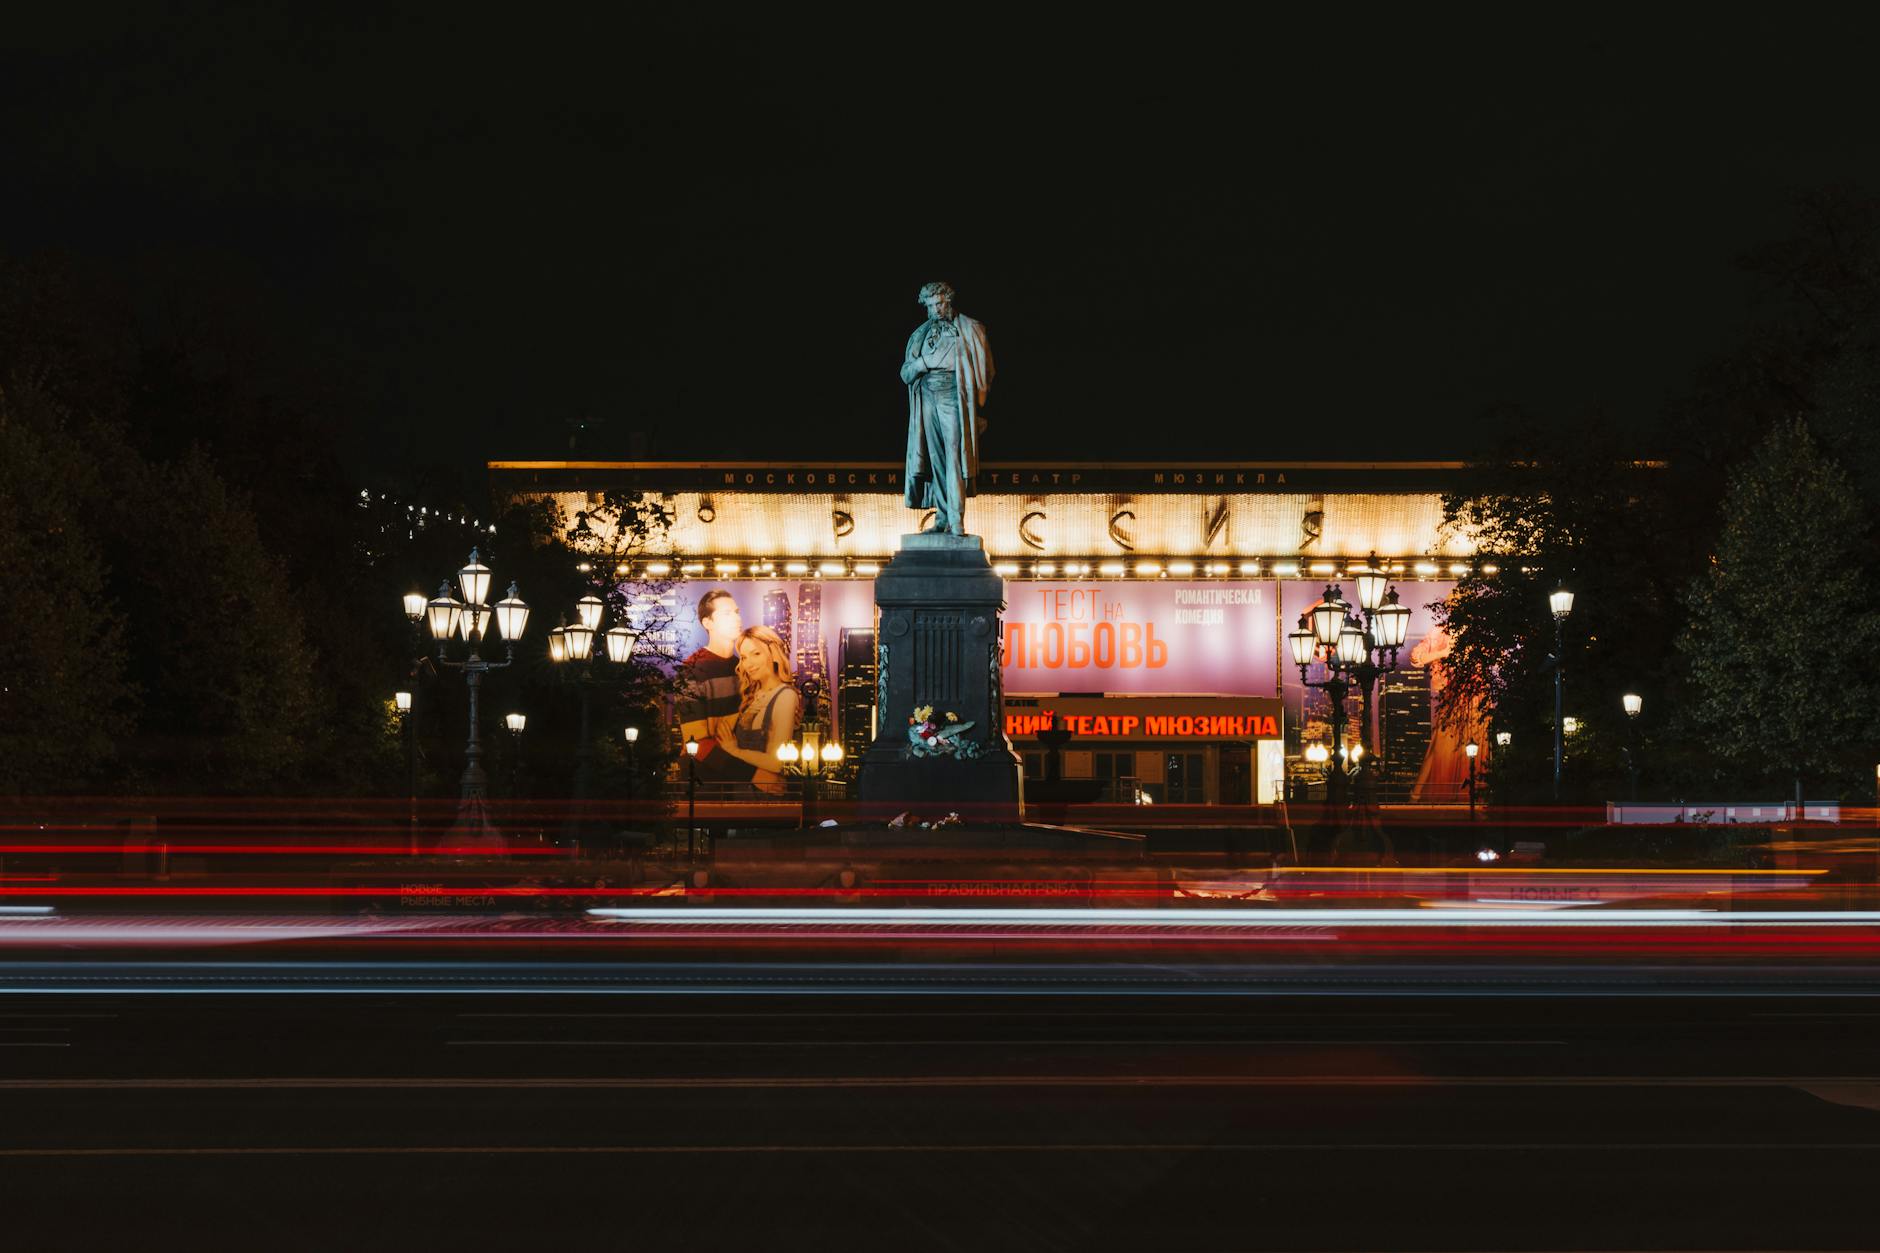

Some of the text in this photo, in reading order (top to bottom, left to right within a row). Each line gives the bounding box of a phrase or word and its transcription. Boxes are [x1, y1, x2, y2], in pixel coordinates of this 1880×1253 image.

[724, 473, 1287, 485] МОСКОВСКИ ТЕАТР МЮЗИКЛА
[1037, 589, 1125, 621] ТЕСТ НА
[1174, 588, 1262, 606] РОМАНТИЧЕСКАЯ
[1174, 608, 1225, 626] КОМЕДИЯ
[1003, 621, 1169, 670] ЛЮБОВЬ
[1063, 714, 1140, 736] ТЕАТР
[1144, 714, 1278, 736] МЮЗИКЛА
[927, 882, 1080, 896] ПРАВИЛЬНАЯ РЫБА
[400, 895, 497, 906] РЫБНЫЕ МЕСТА
